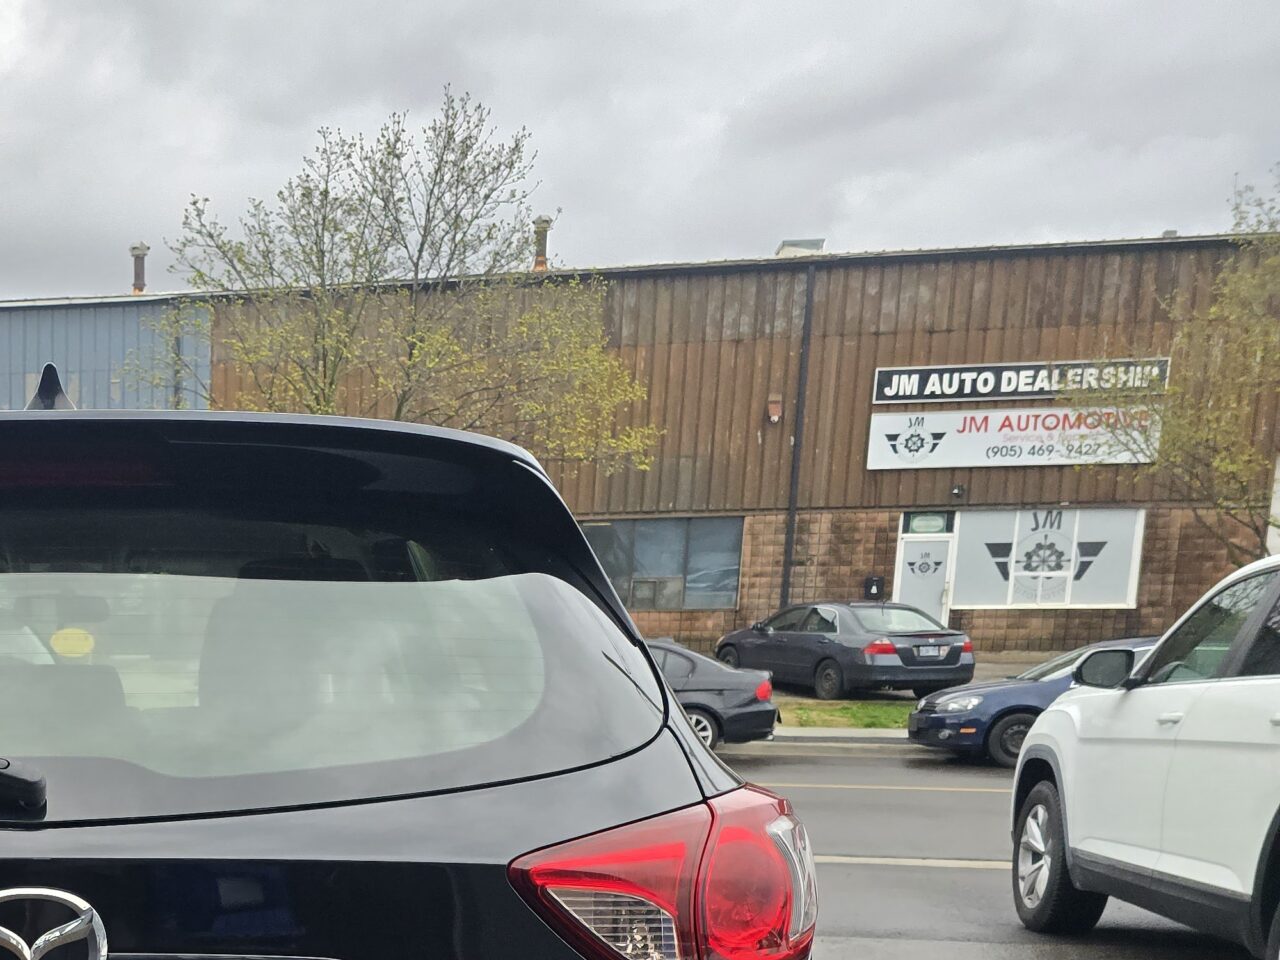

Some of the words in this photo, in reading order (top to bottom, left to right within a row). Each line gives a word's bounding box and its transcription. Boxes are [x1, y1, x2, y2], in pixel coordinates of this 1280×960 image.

[884, 374, 920, 396] JM
[923, 371, 996, 395] AUTO
[1000, 366, 1159, 393] DEALERSHIP
[956, 415, 989, 434] JM
[998, 411, 1149, 433] AUTOMOTIVE
[986, 445, 1023, 459] (905)
[1066, 443, 1101, 456] 9427
